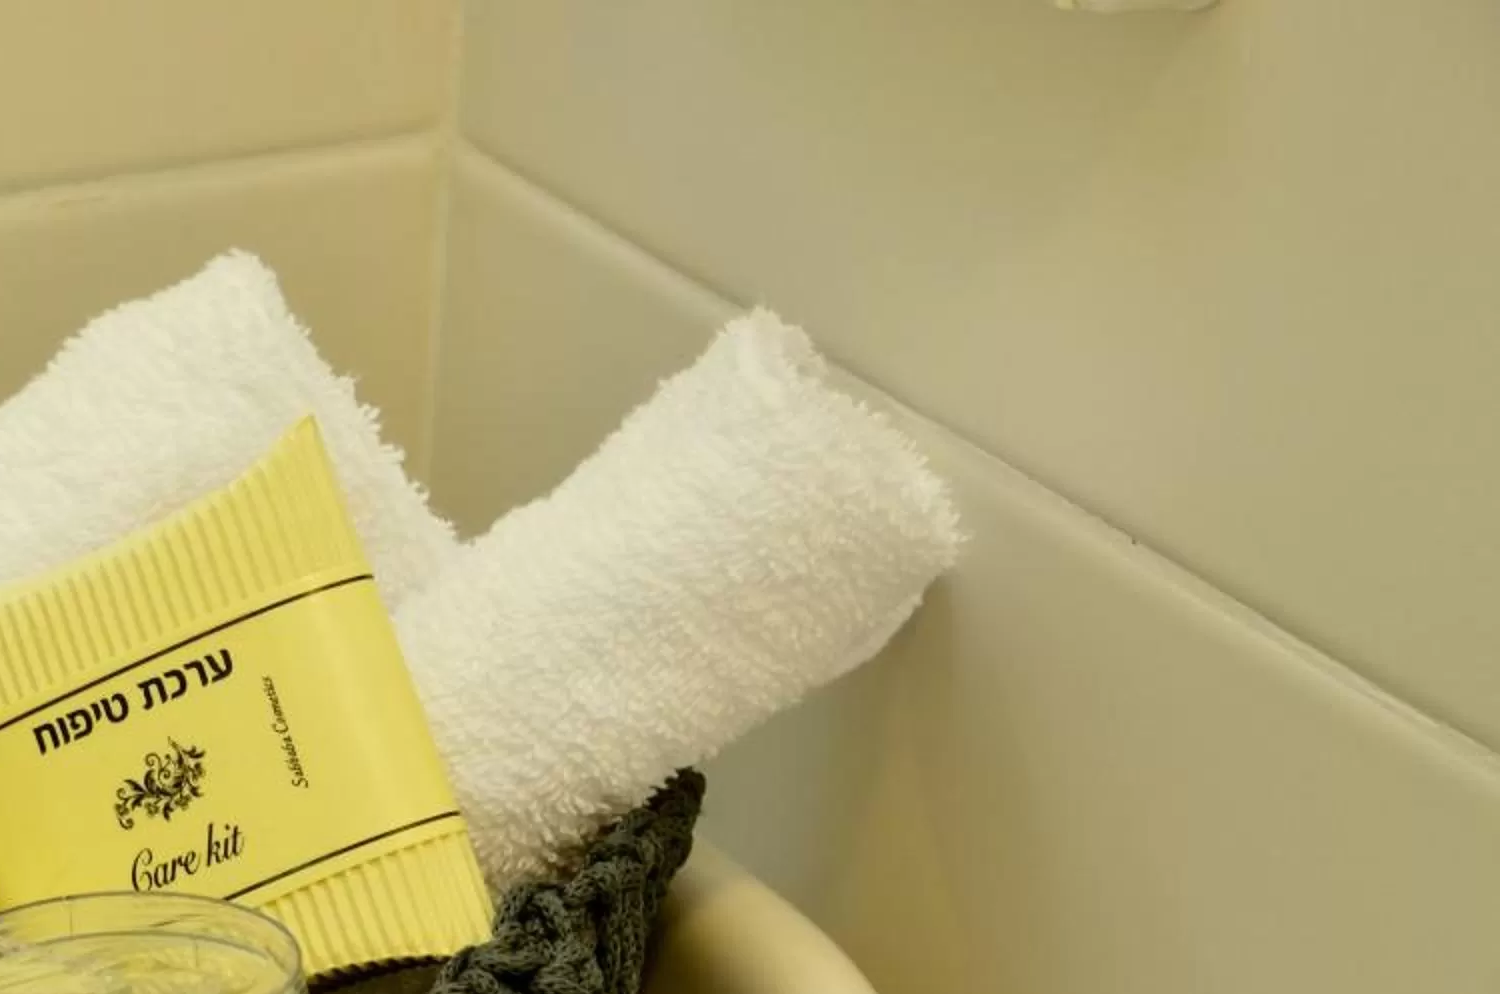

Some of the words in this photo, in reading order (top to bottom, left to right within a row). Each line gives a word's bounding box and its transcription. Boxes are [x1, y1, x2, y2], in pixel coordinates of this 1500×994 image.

[137, 648, 233, 710] ערכת
[32, 692, 129, 756] טיפוח
[131, 847, 200, 892] Care
[206, 822, 245, 868] kit
